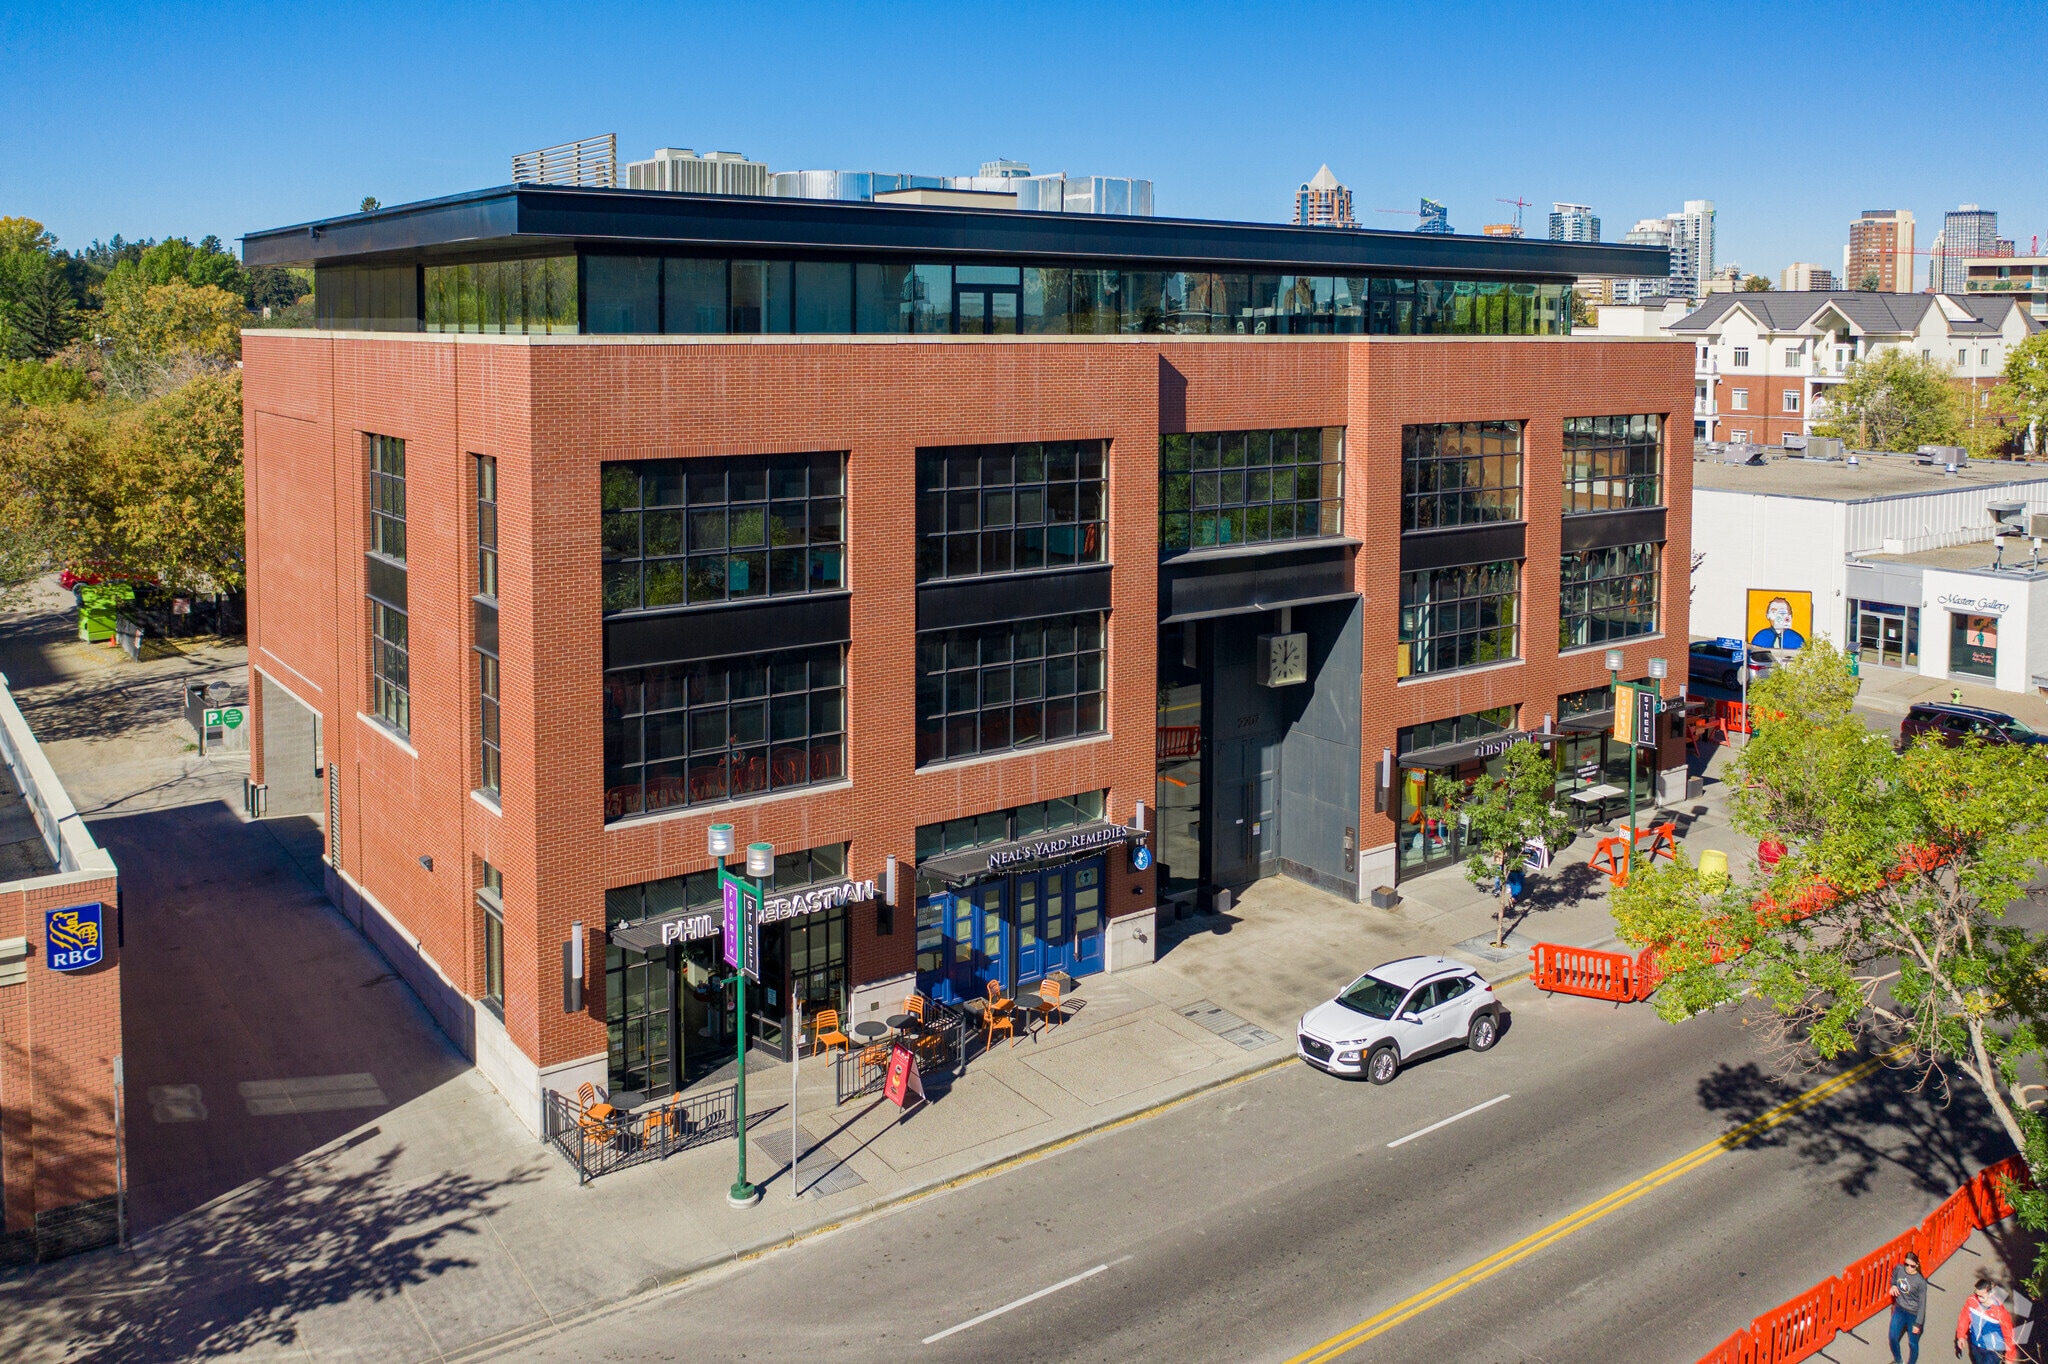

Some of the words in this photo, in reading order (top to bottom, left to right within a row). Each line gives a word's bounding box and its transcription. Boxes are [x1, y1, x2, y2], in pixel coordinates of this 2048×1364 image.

[1937, 593, 1976, 606] Masters
[1975, 598, 2010, 612] Gallery
[208, 713, 219, 725] P
[1035, 839, 1067, 856] YARD
[1071, 826, 1127, 848] REMEDIES
[661, 914, 719, 946] PHIL
[757, 880, 875, 925] EBASTIAN
[53, 947, 98, 967] RBC
